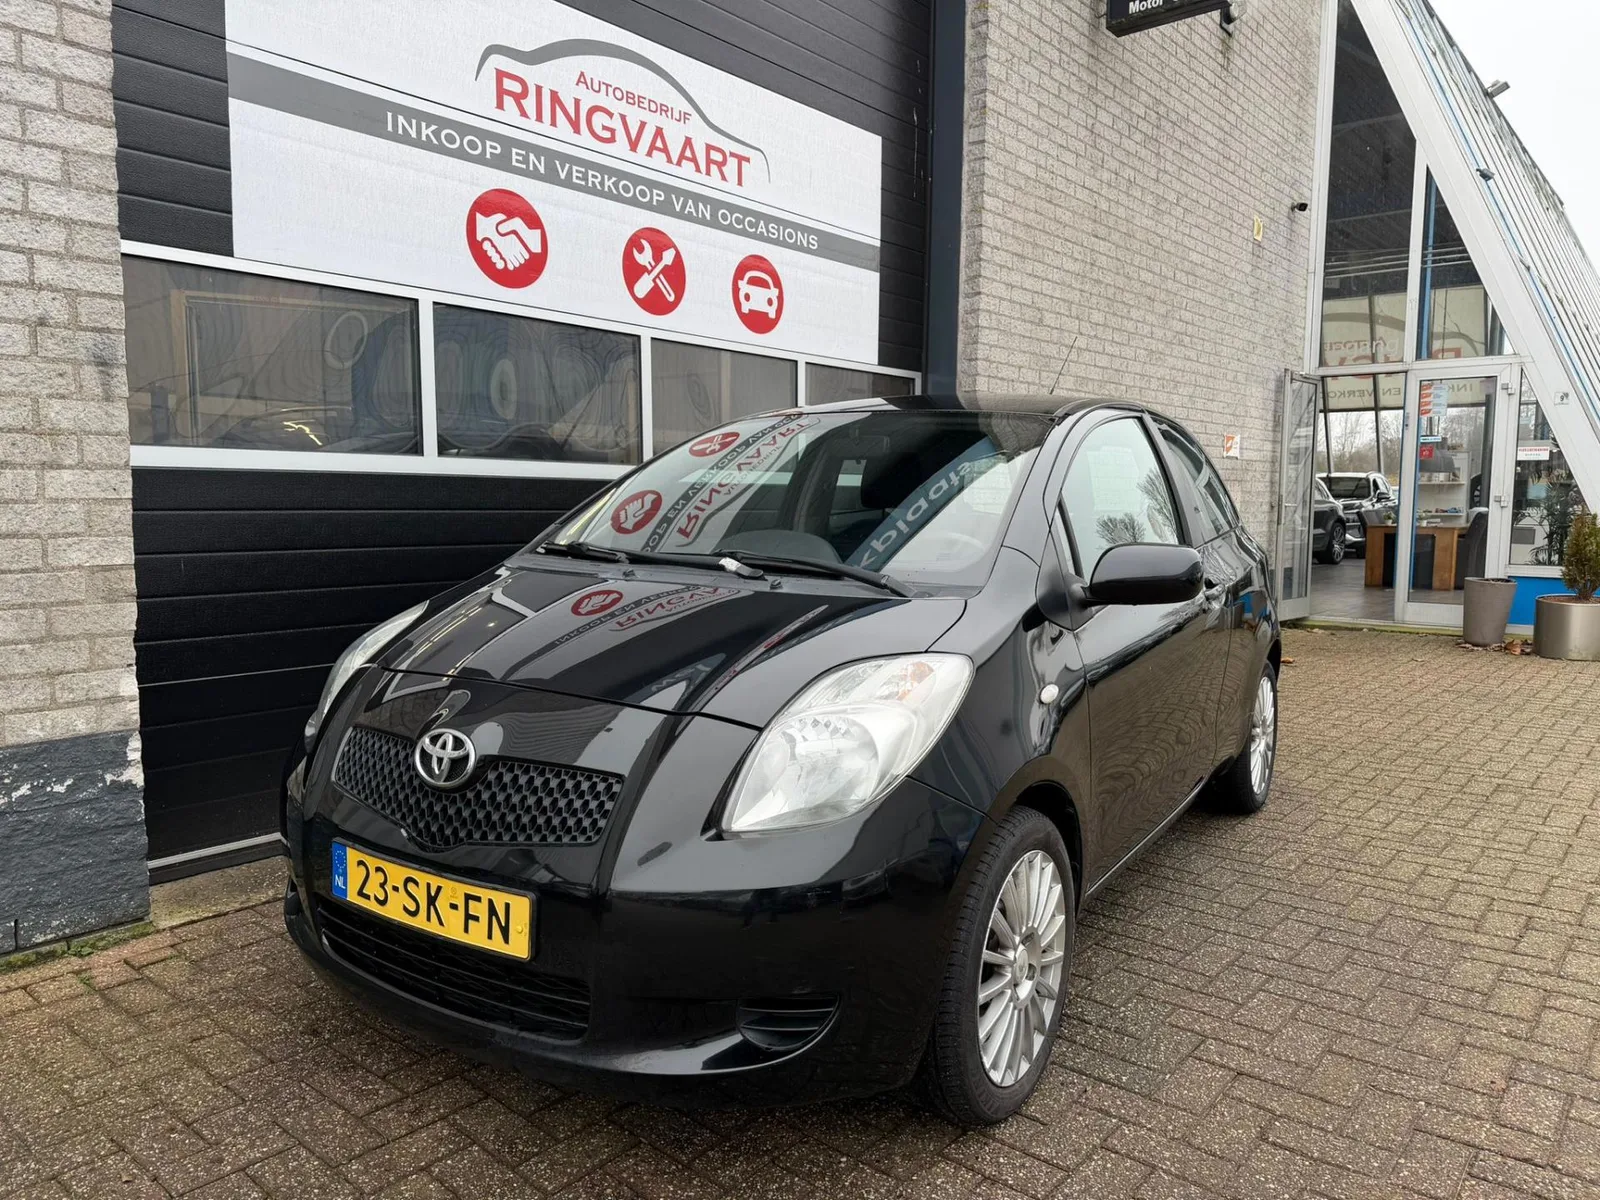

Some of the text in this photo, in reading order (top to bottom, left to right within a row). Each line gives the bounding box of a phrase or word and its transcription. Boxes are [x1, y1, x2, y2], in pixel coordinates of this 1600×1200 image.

[494, 67, 751, 187] RINGVAART
[575, 70, 692, 125] AUTOBEDRIJF
[386, 111, 819, 250] INKOOP EN VERKOOP VAN OCCASIONS
[334, 874, 346, 890] NL
[355, 858, 511, 945] 23-SK-FN
